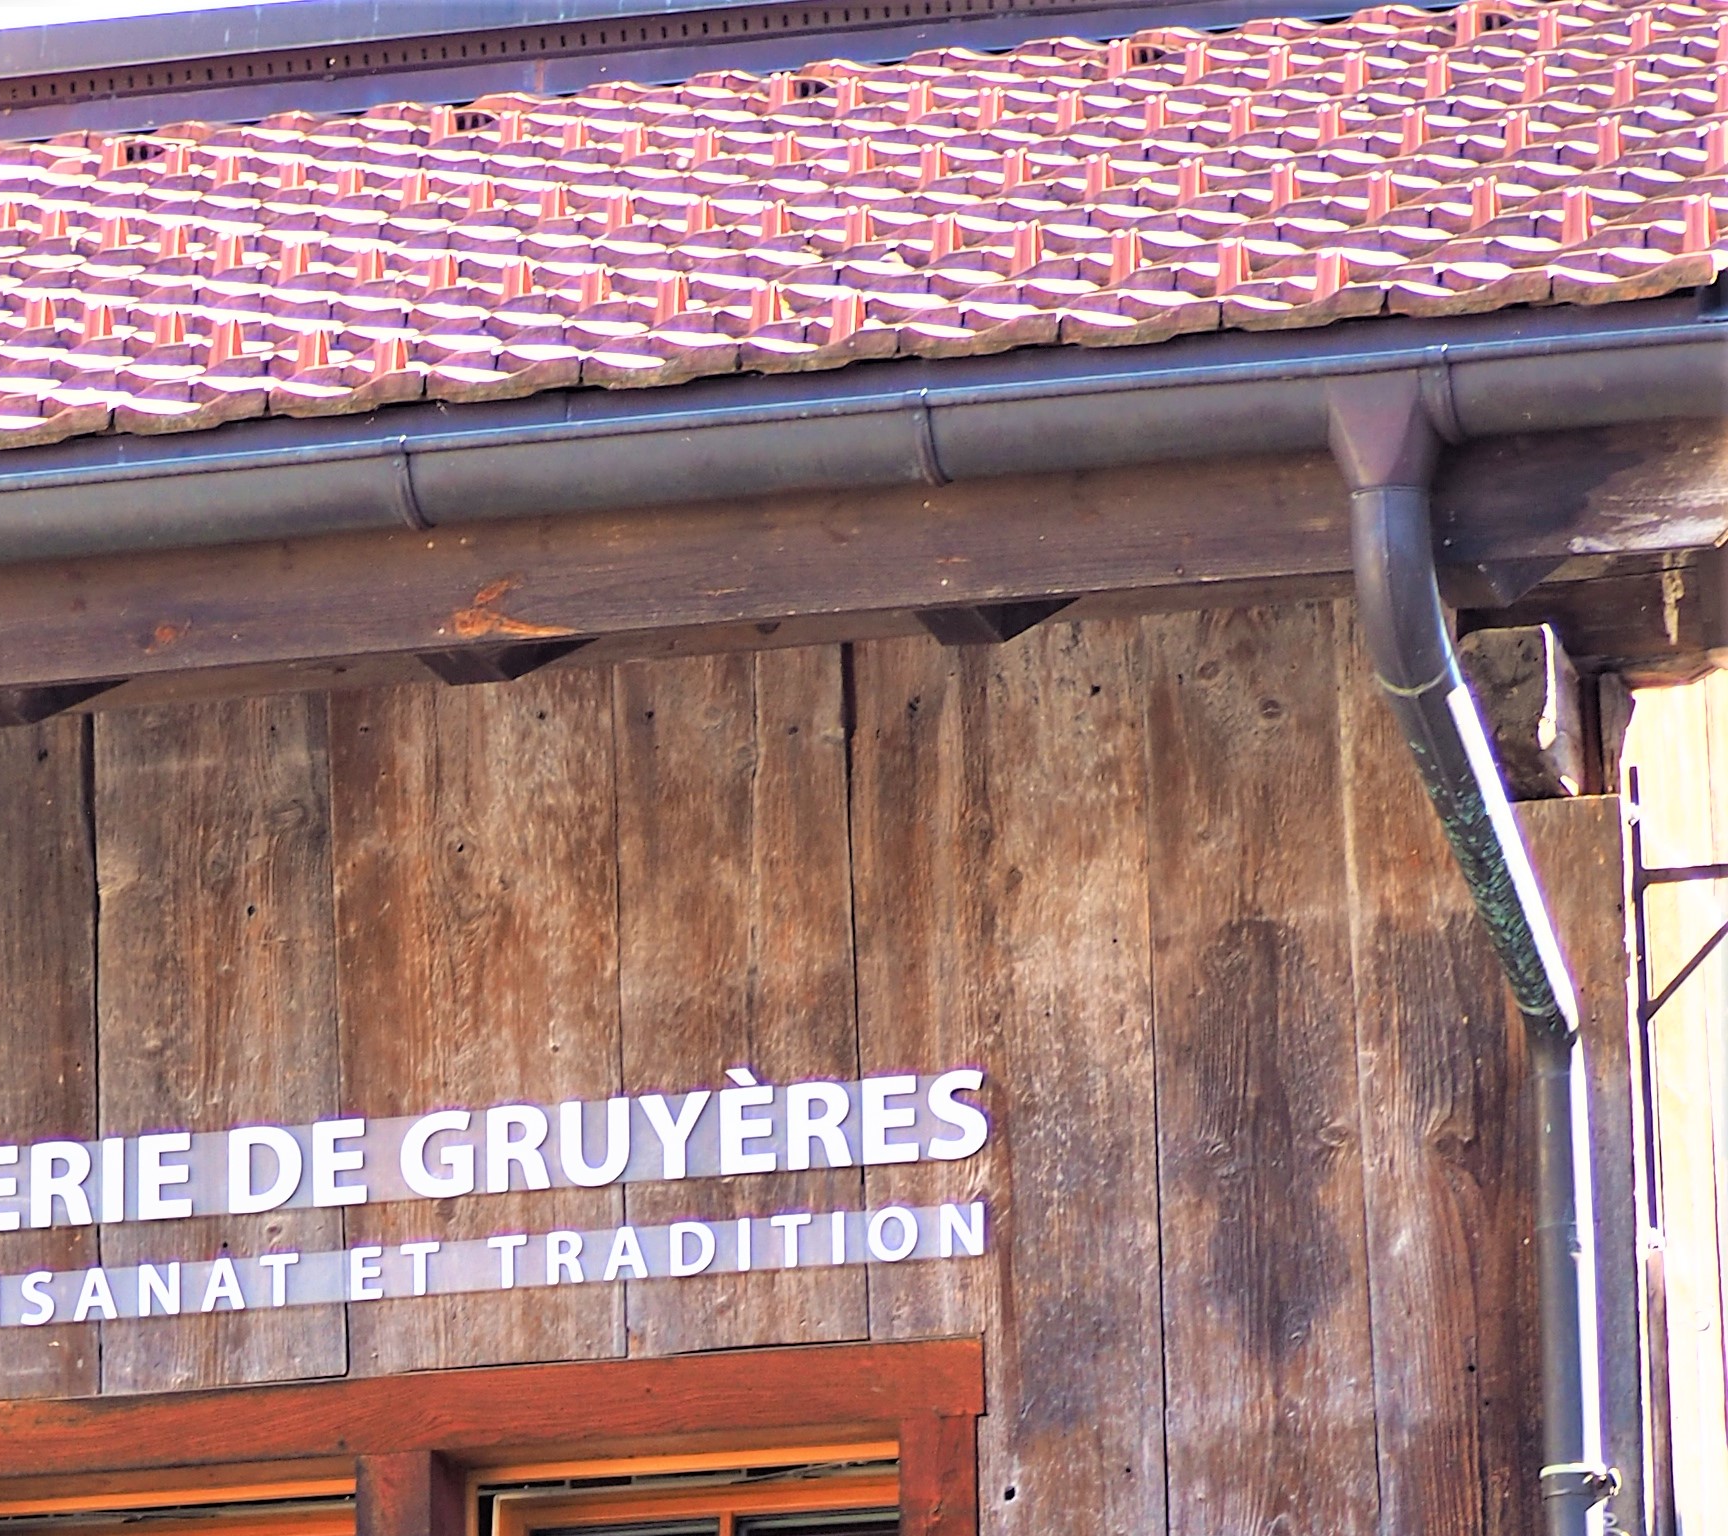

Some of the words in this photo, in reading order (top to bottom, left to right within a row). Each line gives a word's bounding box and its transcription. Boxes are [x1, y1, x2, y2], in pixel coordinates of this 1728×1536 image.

[226, 1117, 368, 1215] DE
[399, 1067, 989, 1199] GRUYÈRES
[348, 1241, 440, 1303] ET
[488, 1201, 985, 1289] TRADITION
